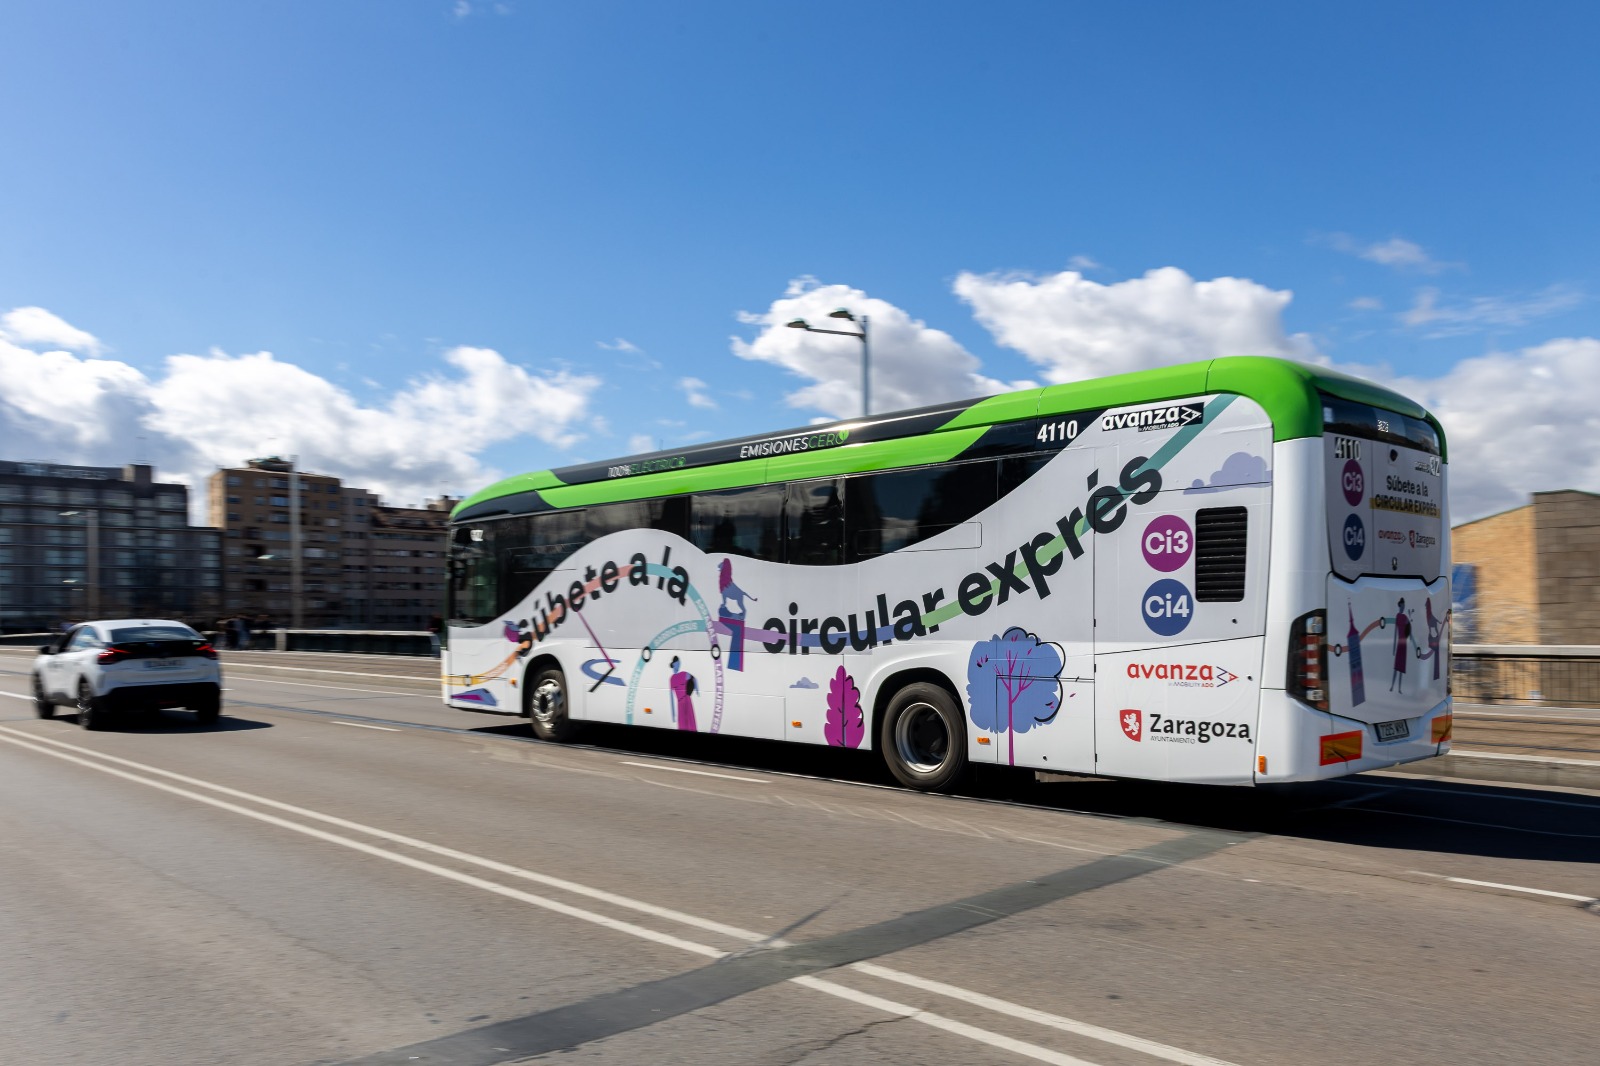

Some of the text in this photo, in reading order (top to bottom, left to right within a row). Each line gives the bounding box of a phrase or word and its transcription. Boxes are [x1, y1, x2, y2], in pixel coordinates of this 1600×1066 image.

[1101, 405, 1181, 431] avanza
[1037, 420, 1078, 442] 4110
[1335, 437, 1361, 460] 4110
[1343, 471, 1364, 493] Ci3
[1386, 475, 1429, 497] Súbete a la
[1375, 494, 1414, 512] CIRCULAR
[1145, 529, 1189, 554] Ci3
[1344, 526, 1364, 546] Ci4
[628, 552, 649, 586] a
[657, 545, 689, 606] la
[761, 587, 946, 655] circular
[957, 456, 1163, 616] exprés
[1145, 592, 1189, 618] Ci4
[1127, 663, 1214, 681] avanza
[1149, 713, 1250, 743] Zaragoza
